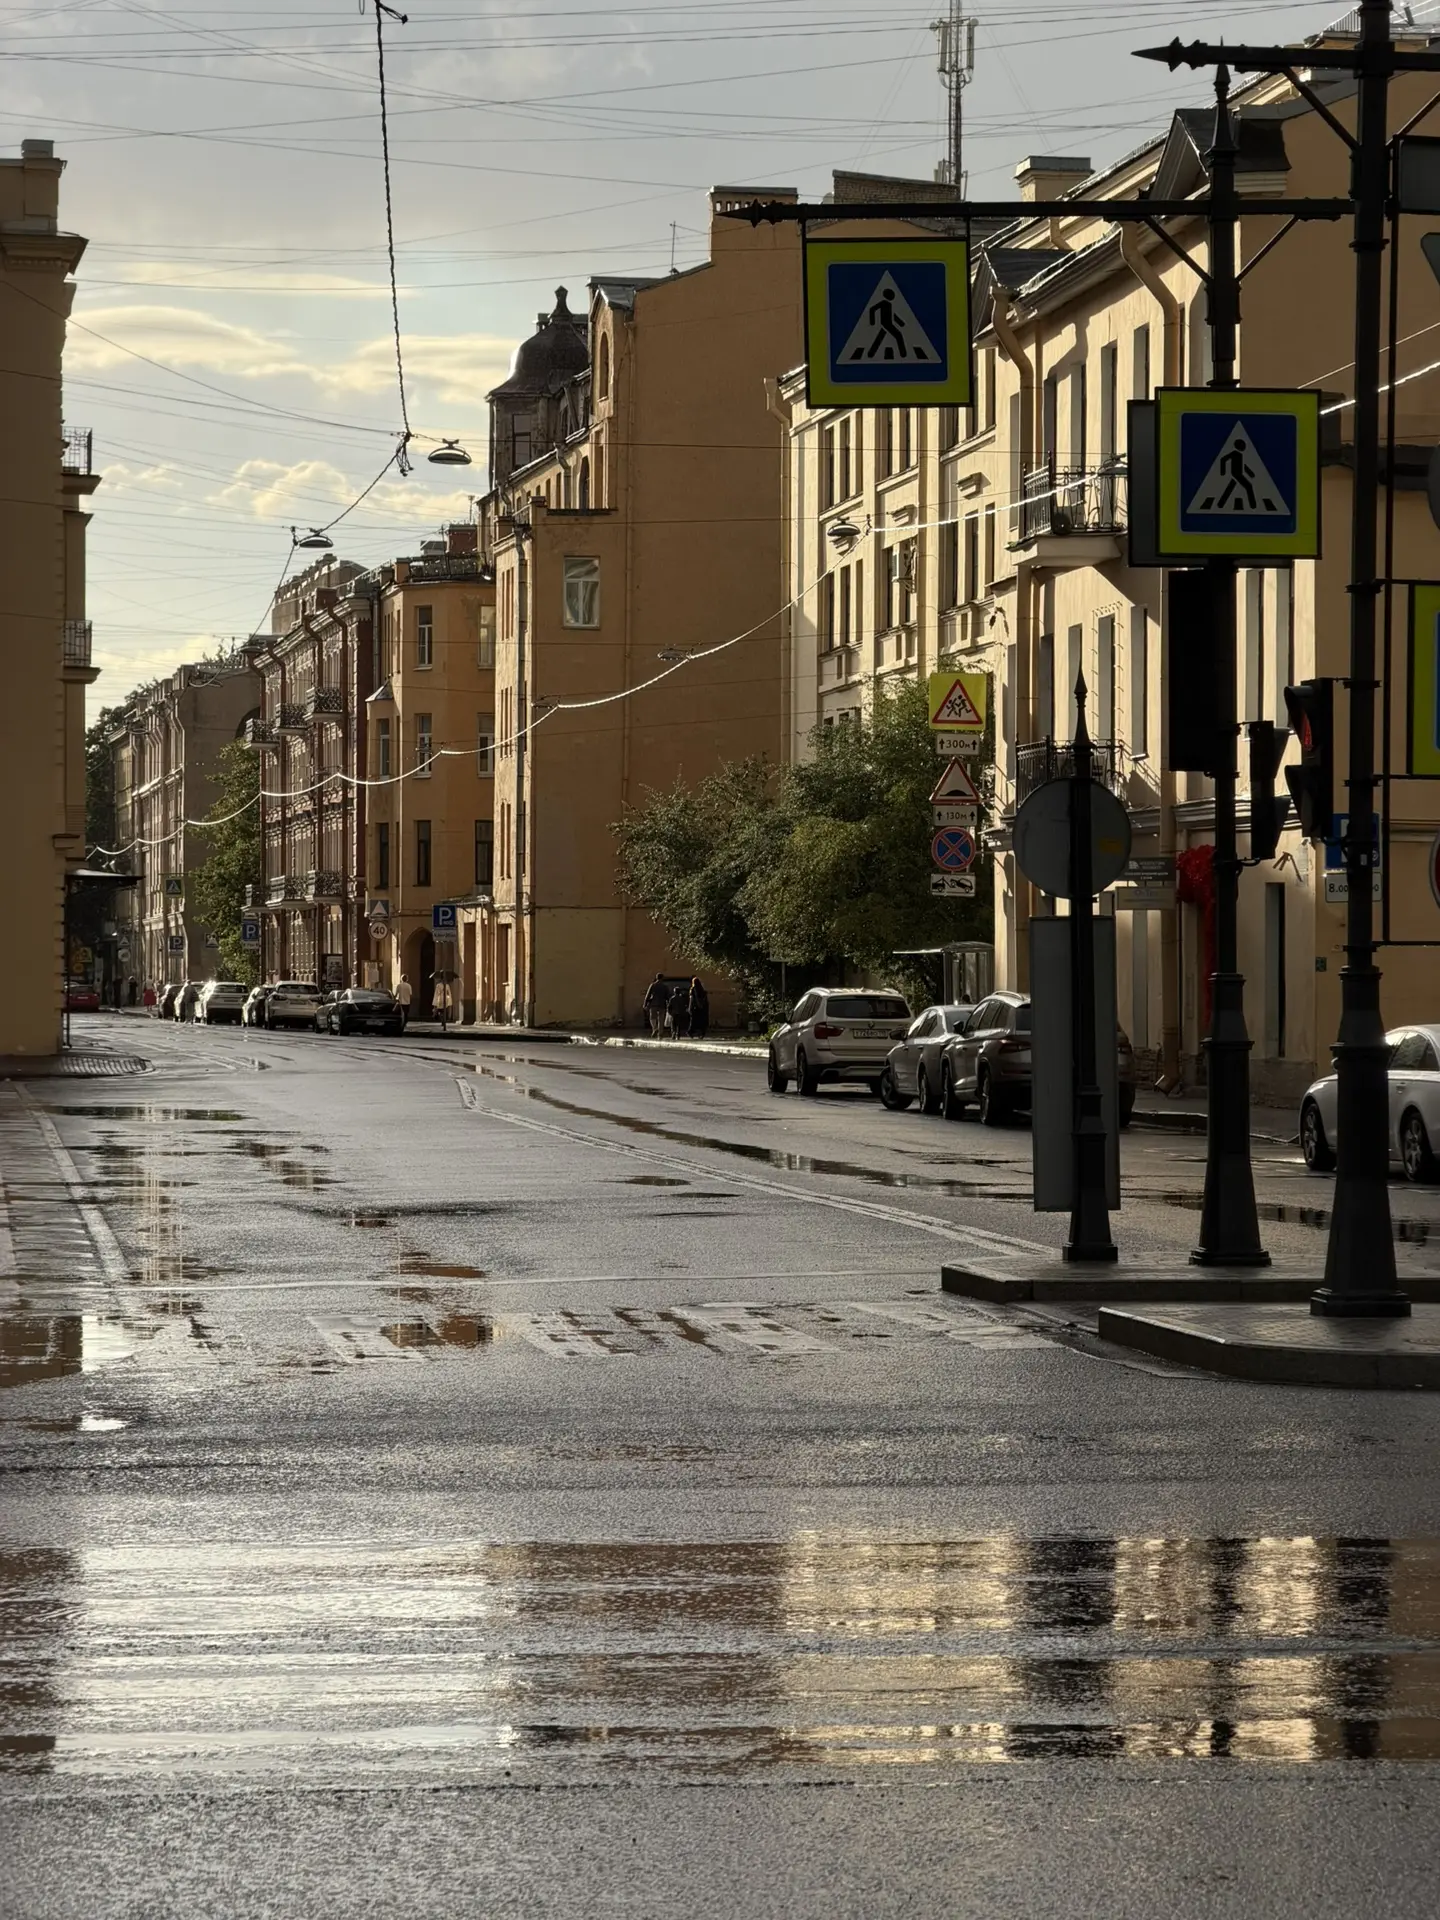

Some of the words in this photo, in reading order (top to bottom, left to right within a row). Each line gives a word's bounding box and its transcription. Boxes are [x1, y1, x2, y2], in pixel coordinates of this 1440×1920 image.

[439, 907, 452, 926] P
[247, 925, 256, 938] P
[373, 926, 385, 935] 40
[173, 937, 181, 948] P
